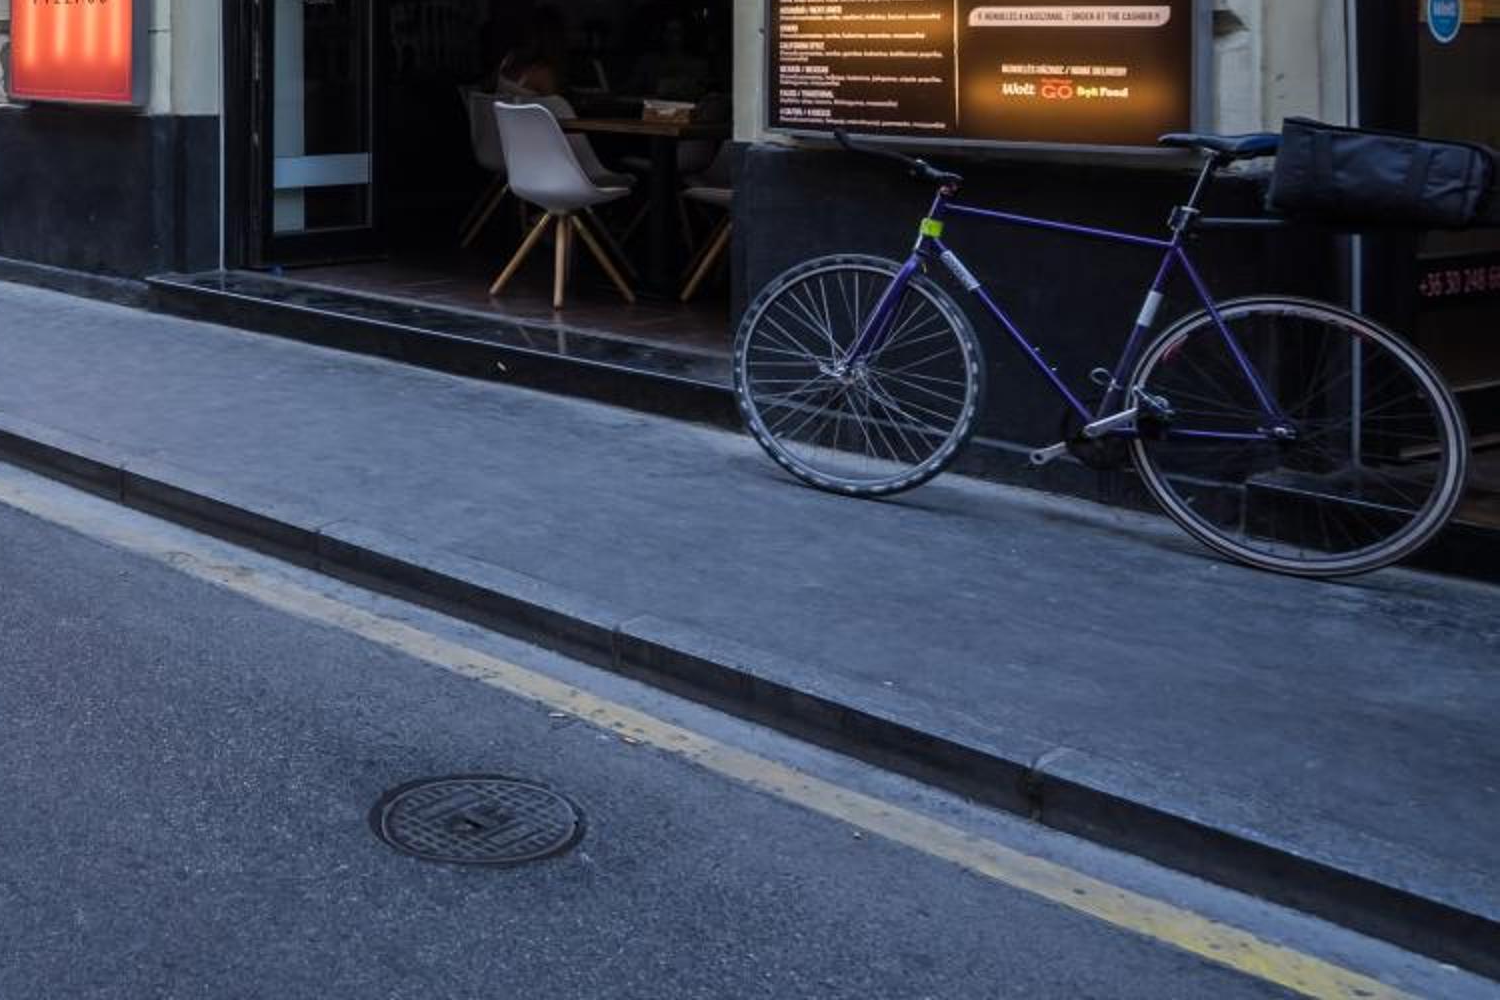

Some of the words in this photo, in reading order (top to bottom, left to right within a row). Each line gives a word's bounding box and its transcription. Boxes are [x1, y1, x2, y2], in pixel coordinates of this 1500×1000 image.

[1002, 82, 1036, 97] Wolt
[1041, 85, 1073, 100] GO
[1099, 87, 1129, 98] Food
